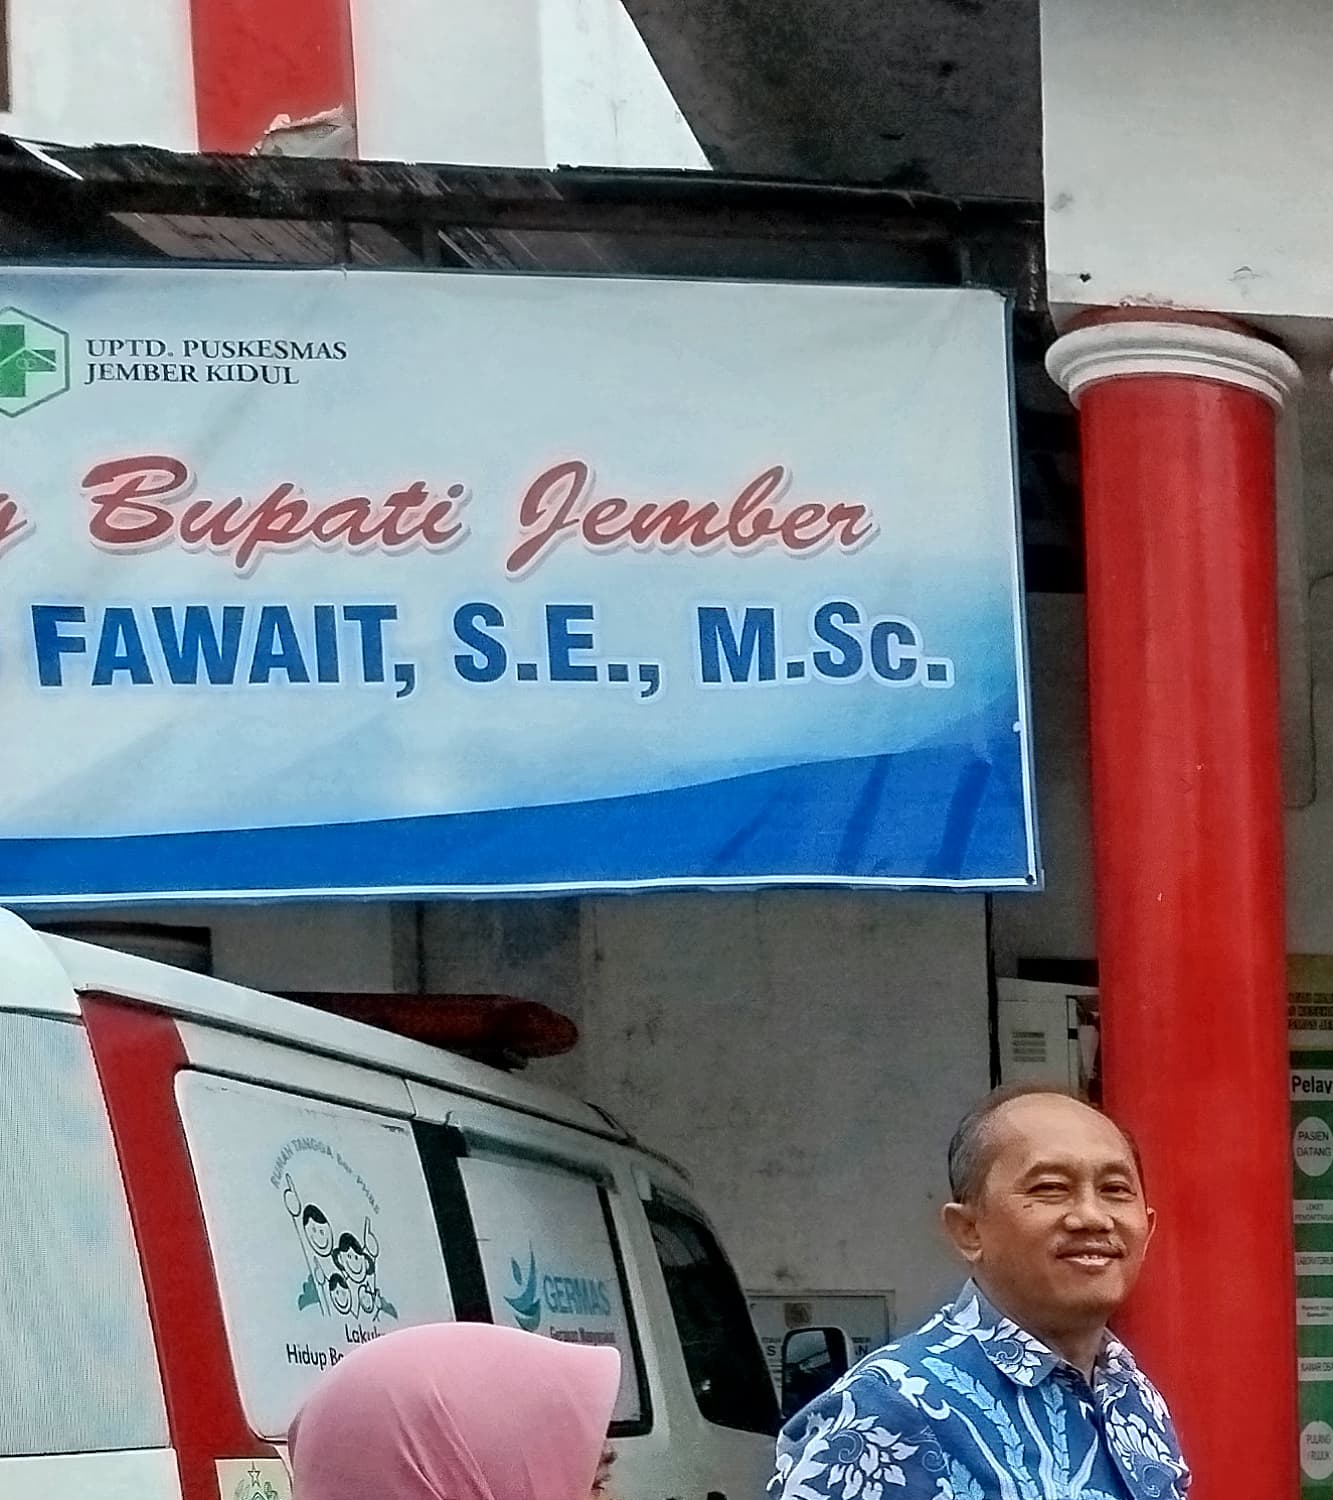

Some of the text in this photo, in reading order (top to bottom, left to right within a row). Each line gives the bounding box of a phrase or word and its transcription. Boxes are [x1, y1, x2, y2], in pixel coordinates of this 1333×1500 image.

[86, 338, 348, 361] UPTD. PUSKESMAS
[84, 362, 300, 385] JEMBER KIDUL
[80, 455, 466, 569] Bupati
[506, 459, 874, 573] Jember
[30, 601, 949, 699] FAWAIT, S.E., M.Sc.
[1298, 1131, 1329, 1141] PASIEN
[1296, 1147, 1332, 1157] DATANG
[543, 1274, 612, 1316] GERMAS
[286, 1343, 327, 1371] Hidup
